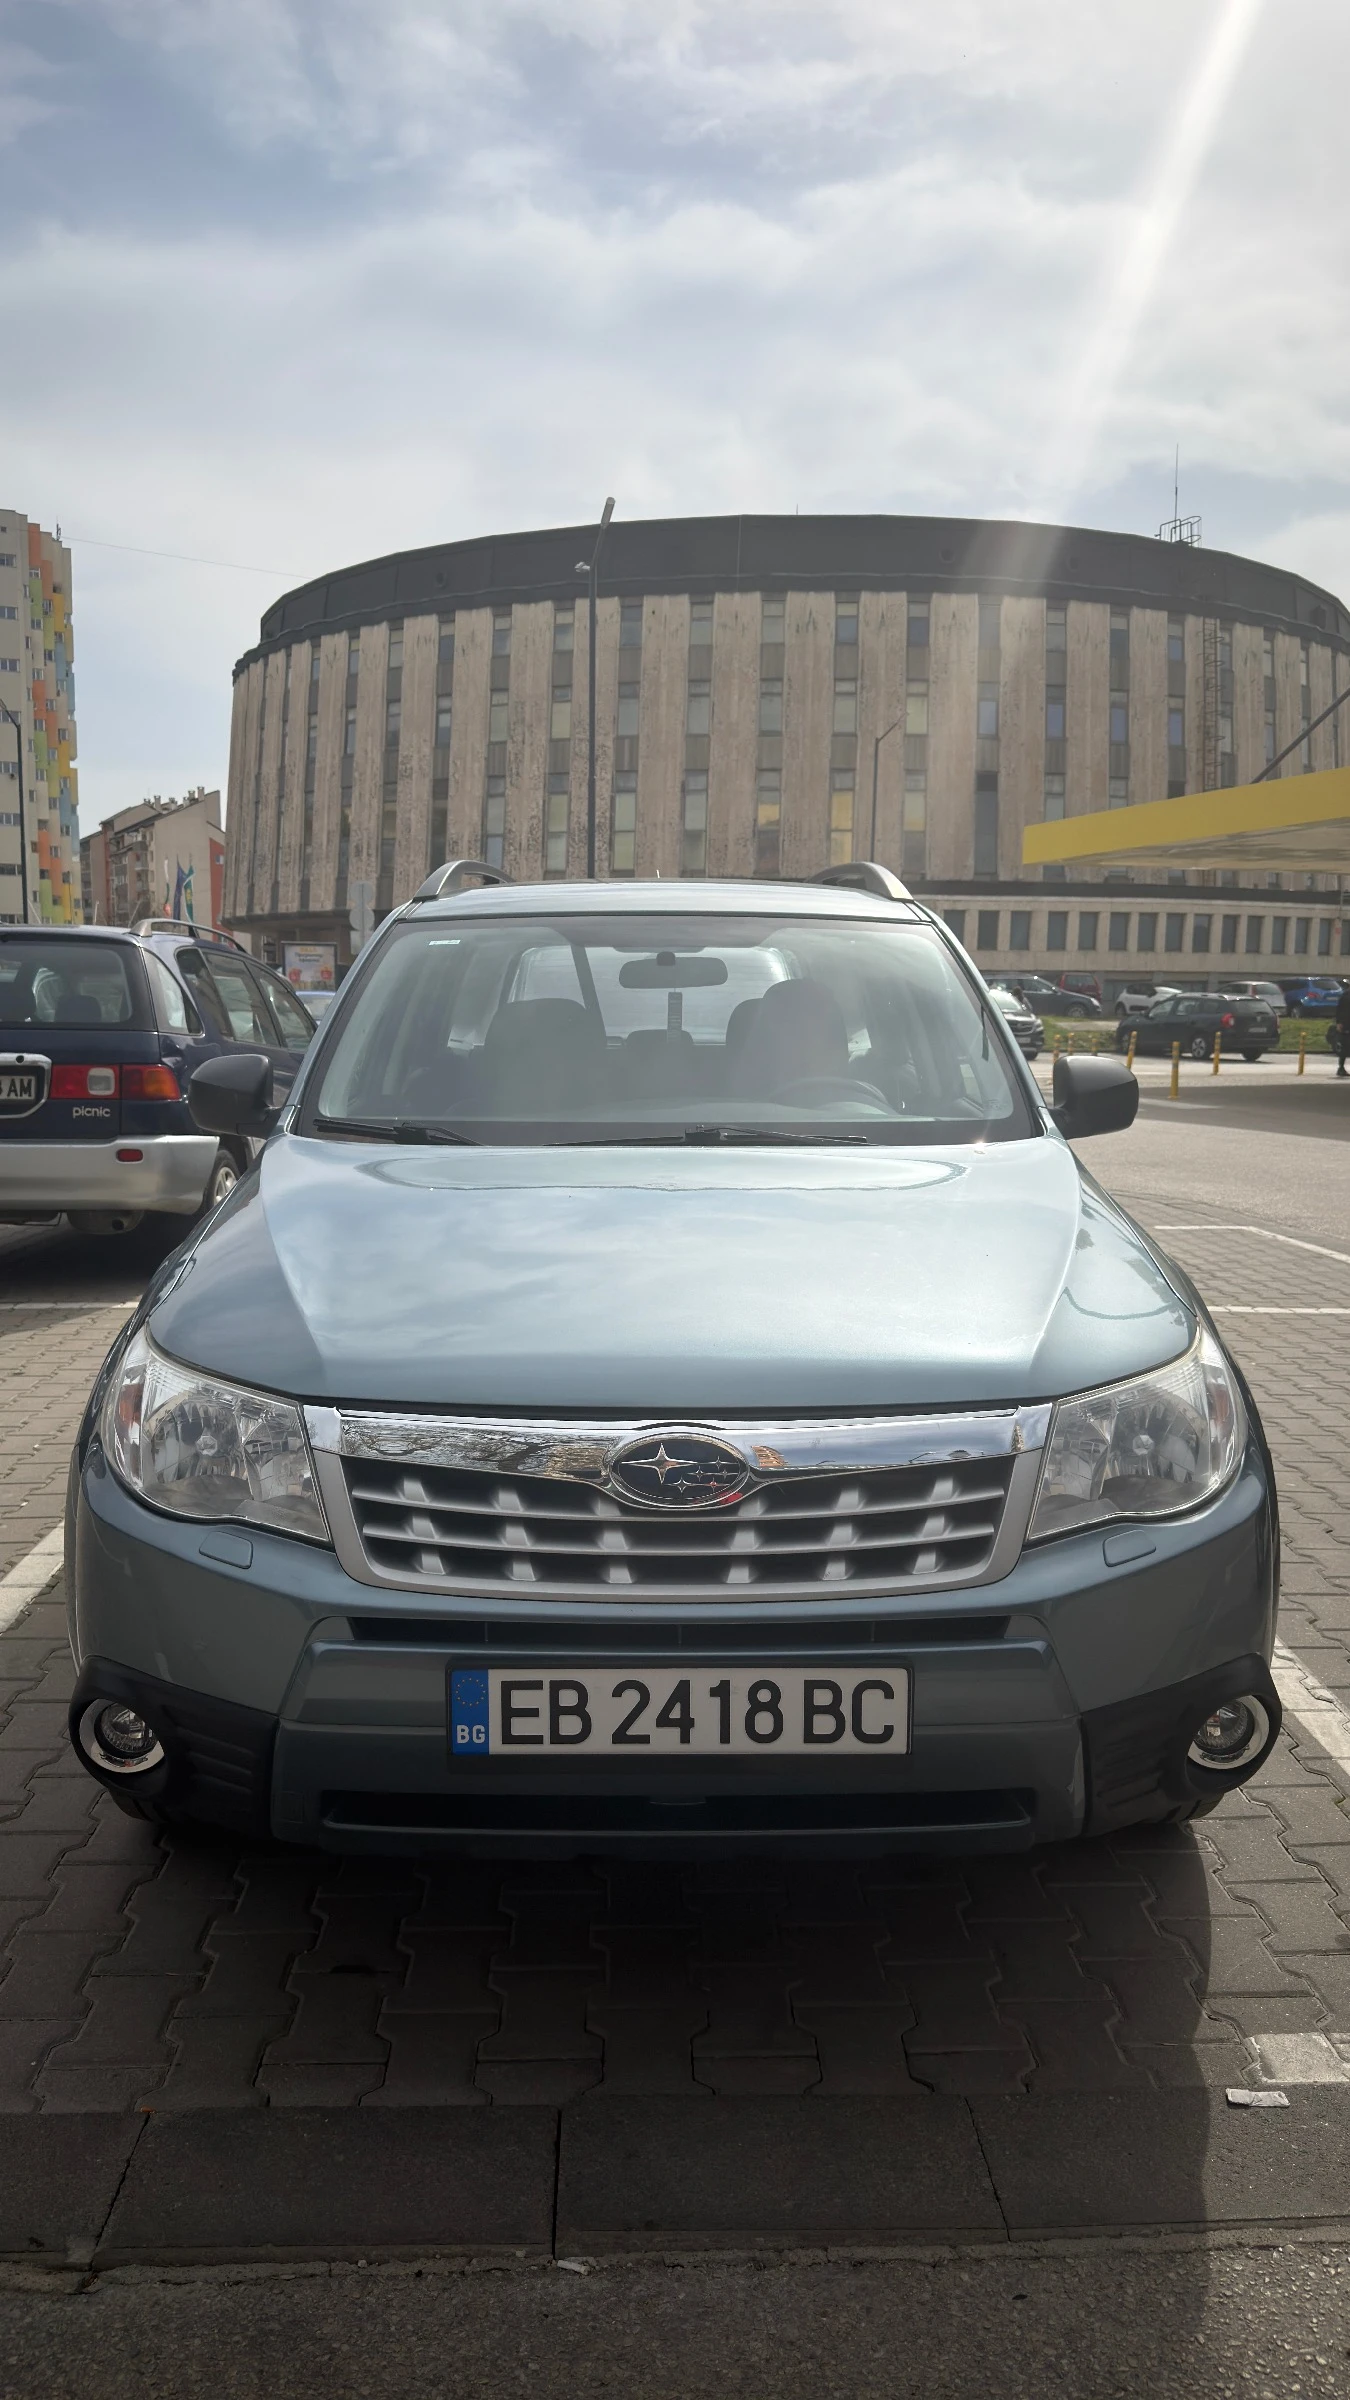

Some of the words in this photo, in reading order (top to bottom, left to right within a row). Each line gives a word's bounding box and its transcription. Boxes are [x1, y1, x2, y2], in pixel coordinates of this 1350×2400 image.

[7, 1079, 32, 1097] AM
[73, 1106, 111, 1118] picnic
[501, 1680, 592, 1744] EB
[611, 1680, 784, 1744] 2418
[803, 1680, 895, 1744] BC
[457, 1725, 485, 1743] BG
